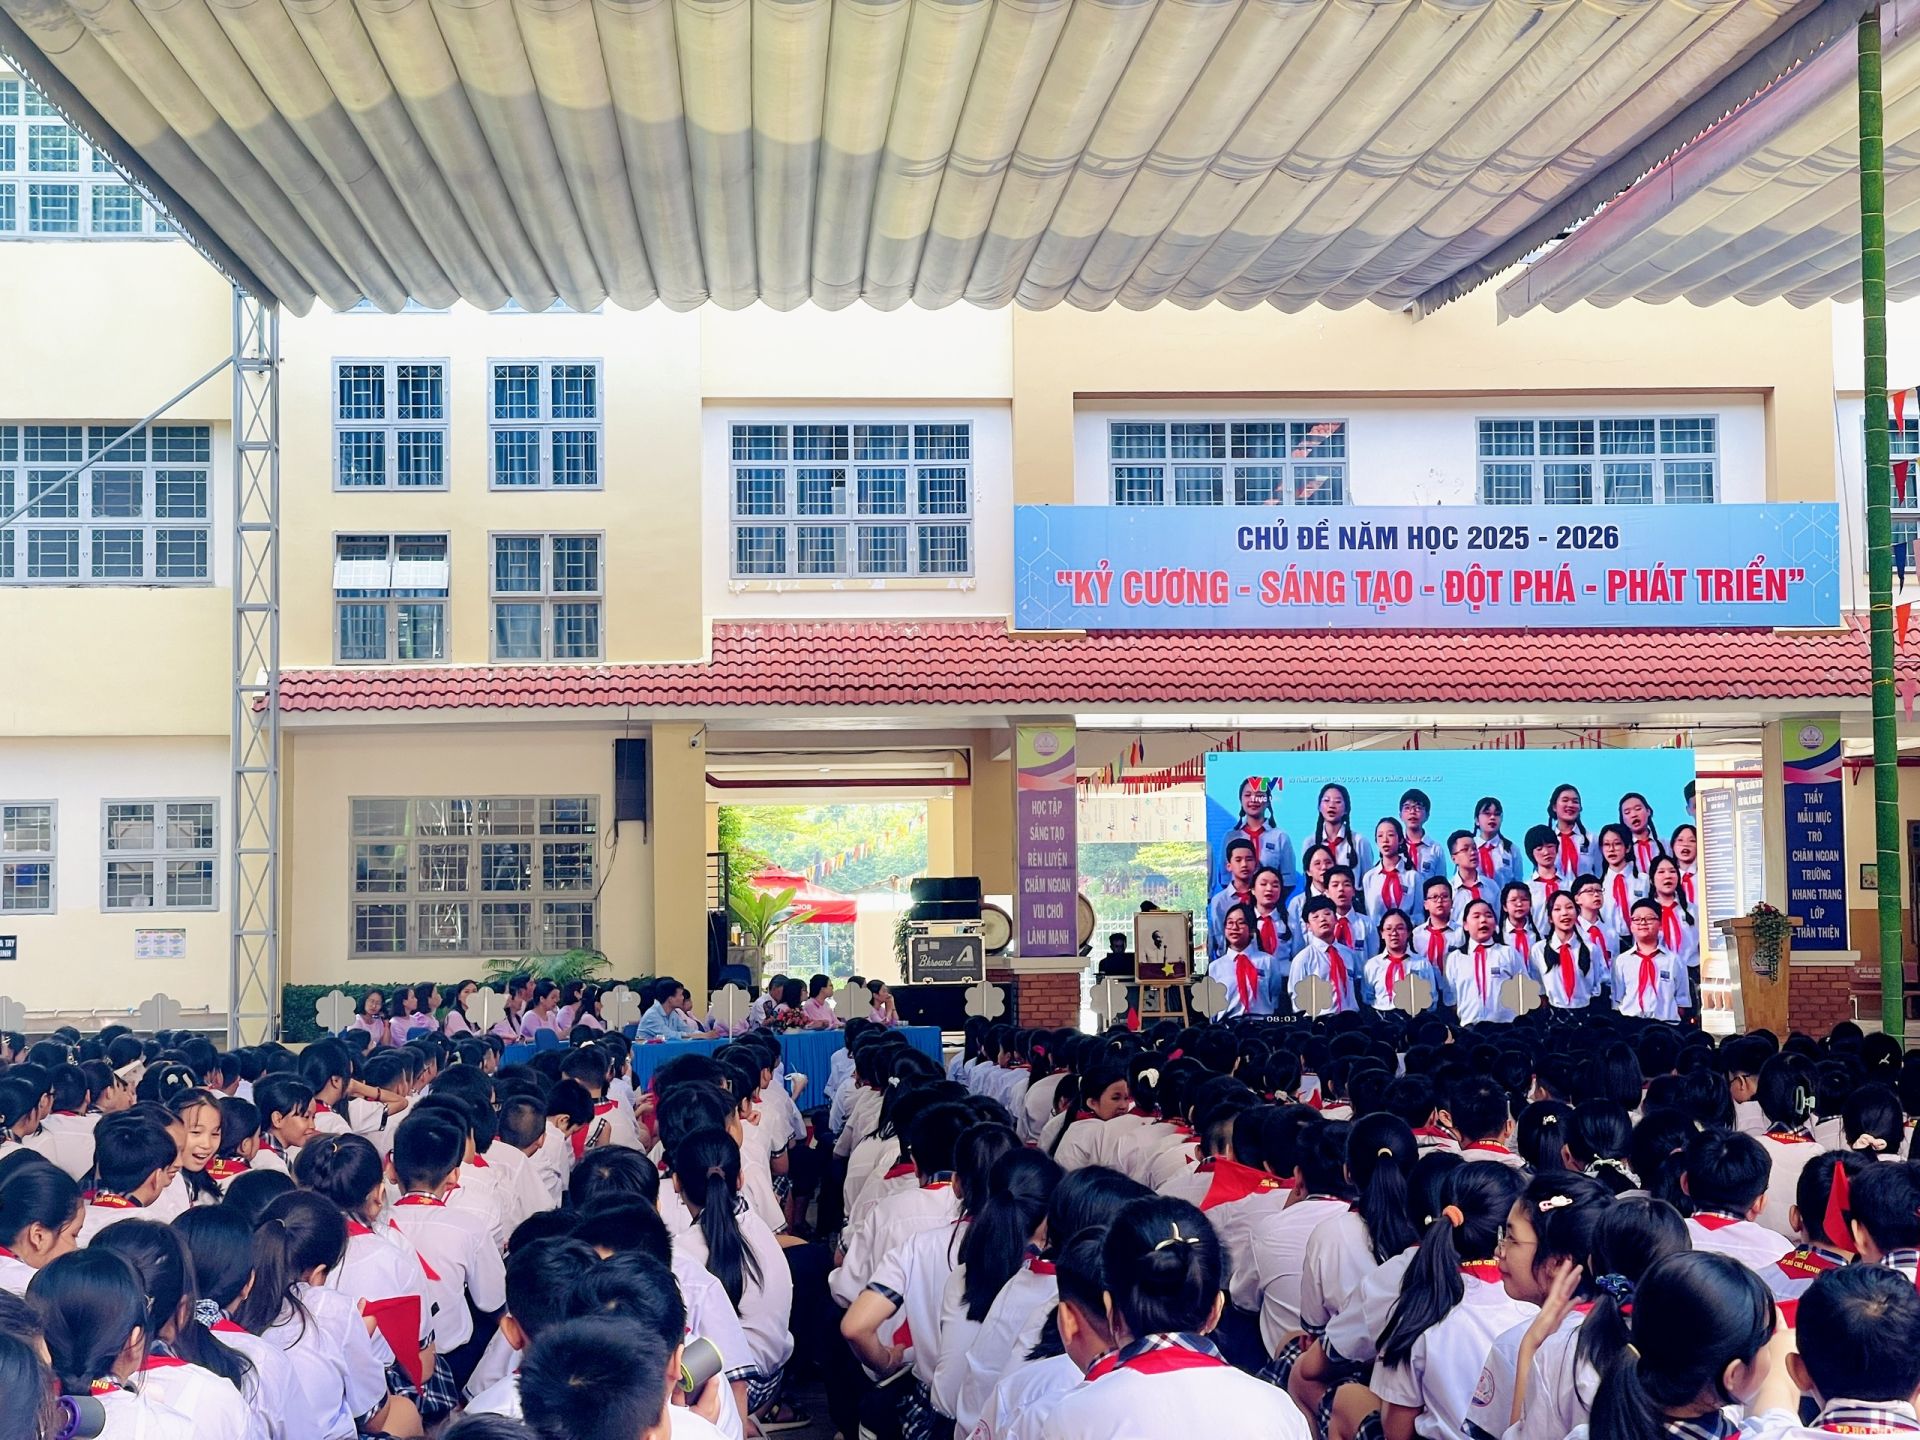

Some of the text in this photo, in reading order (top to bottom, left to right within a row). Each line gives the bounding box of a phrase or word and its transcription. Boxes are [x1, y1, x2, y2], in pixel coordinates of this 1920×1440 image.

[1237, 518, 1289, 550] CHỦ
[1296, 518, 1330, 550] ĐỀ
[1338, 521, 1398, 550] NĂM
[1407, 526, 1459, 555] HỌC
[1467, 525, 1530, 550] 2025
[1556, 525, 1619, 550] 2026
[1123, 567, 1229, 604] CƯƠNG
[1261, 563, 1345, 604] SÁNG
[1355, 570, 1413, 611] TẠO
[1445, 563, 1503, 611] ĐỘT
[1513, 562, 1576, 603] PHÁ
[1607, 562, 1687, 602] PHÁT
[1247, 775, 1284, 793] VTV1
[1031, 796, 1063, 818] HỌC TẬP
[1797, 806, 1832, 825] MẪU MỰC
[1030, 822, 1065, 843] SÁNG TẠO
[1807, 828, 1823, 842] TRÒ
[1027, 848, 1068, 869] RÈN LUYỆN
[1792, 847, 1839, 862] CHĂM NGOAN
[1801, 866, 1831, 880] TRƯỜNG
[1025, 875, 1071, 893] CHĂM NGOAN
[1792, 888, 1842, 900] KHANG TRANG
[1032, 901, 1064, 918] VUI CHƠI
[1810, 905, 1825, 919] LỚP
[1027, 926, 1069, 947] LÀNH MẠNH
[1796, 924, 1840, 940] THÂN THIỆN
[1266, 1015, 1297, 1023] 08:03
